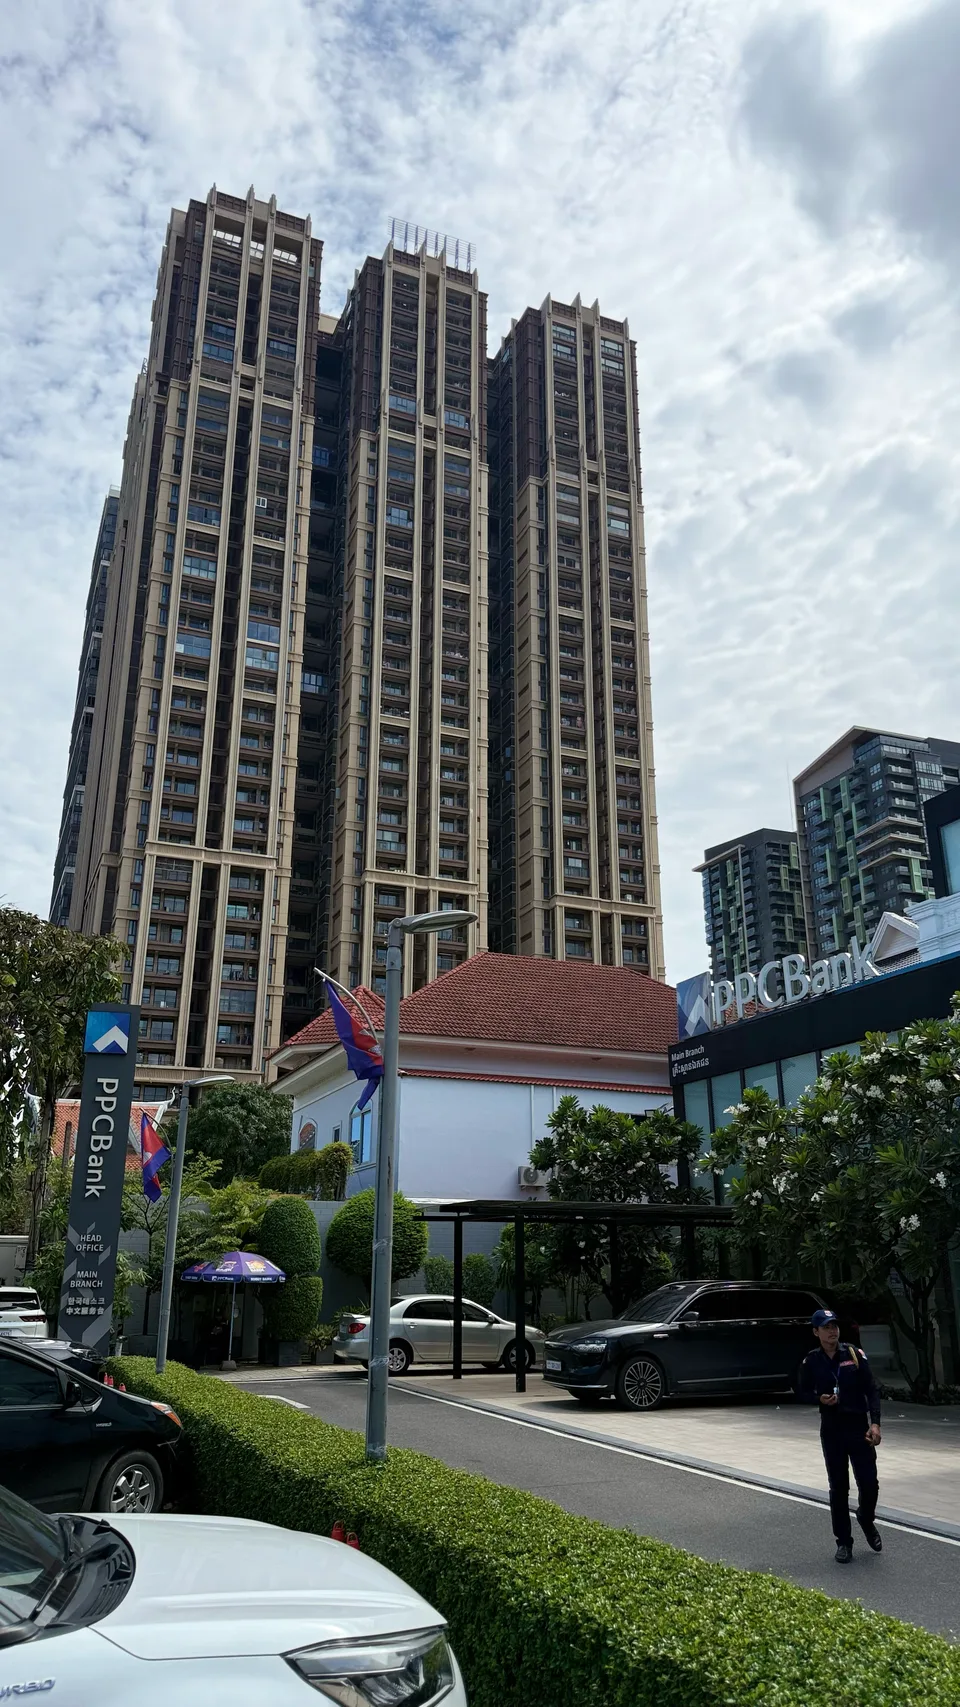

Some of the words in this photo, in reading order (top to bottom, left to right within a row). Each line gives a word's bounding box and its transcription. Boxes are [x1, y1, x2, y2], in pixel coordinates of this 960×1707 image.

[713, 935, 880, 1025] PPCBank
[671, 1051, 685, 1061] Main
[685, 1044, 705, 1058] Branch
[85, 1077, 119, 1198] PPCBank
[80, 1234, 102, 1242] HEAD
[75, 1244, 104, 1252] OFFICE
[76, 1270, 98, 1278] MAIN
[70, 1280, 103, 1288] BRANCH
[68, 1297, 105, 1305] 한국데스크
